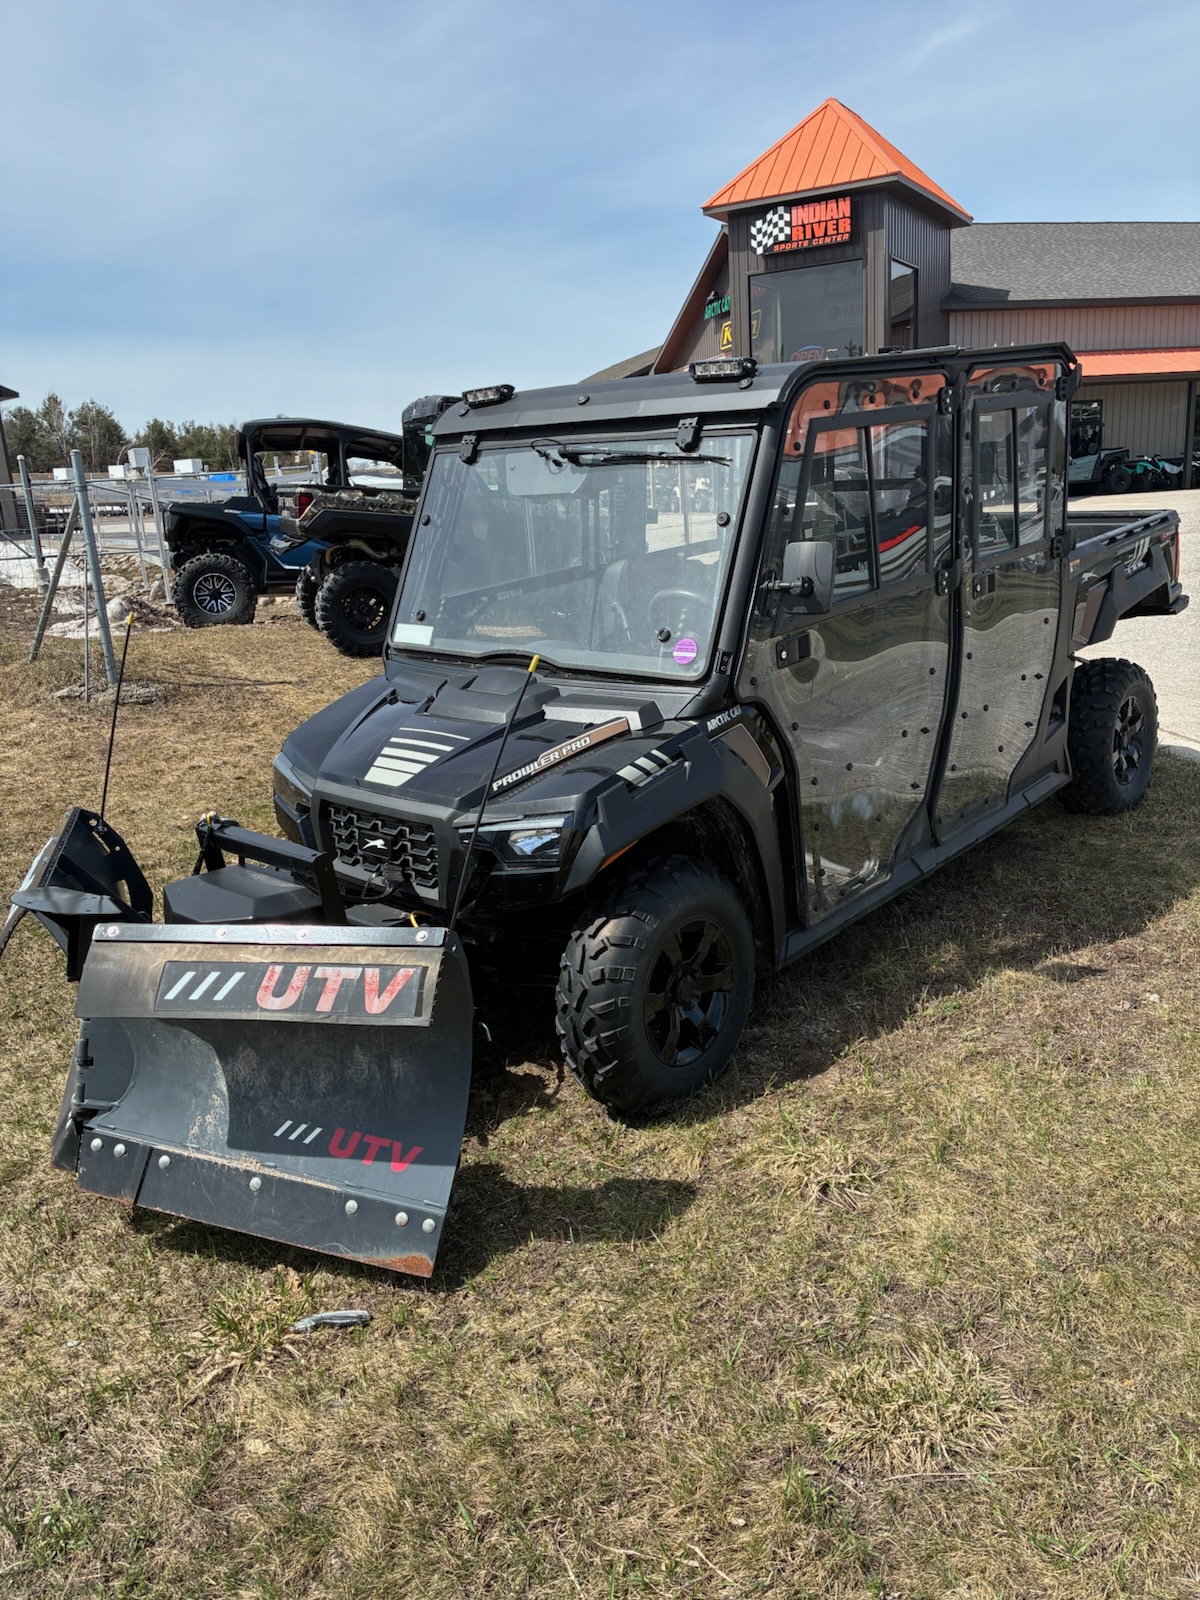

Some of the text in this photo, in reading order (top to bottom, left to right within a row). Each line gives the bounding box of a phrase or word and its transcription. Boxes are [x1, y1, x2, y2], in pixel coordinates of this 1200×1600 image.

[791, 197, 851, 226] INDIAN
[773, 234, 849, 252] SPORTS CENTER
[791, 217, 851, 241] RIVER
[704, 299, 722, 320] ARCTIC
[791, 350, 824, 361] OPEN
[706, 704, 742, 732] ARCTIC CAT
[492, 736, 591, 792] PROWLER PRO
[256, 965, 417, 1015] UTV
[328, 1127, 424, 1173] UTV
